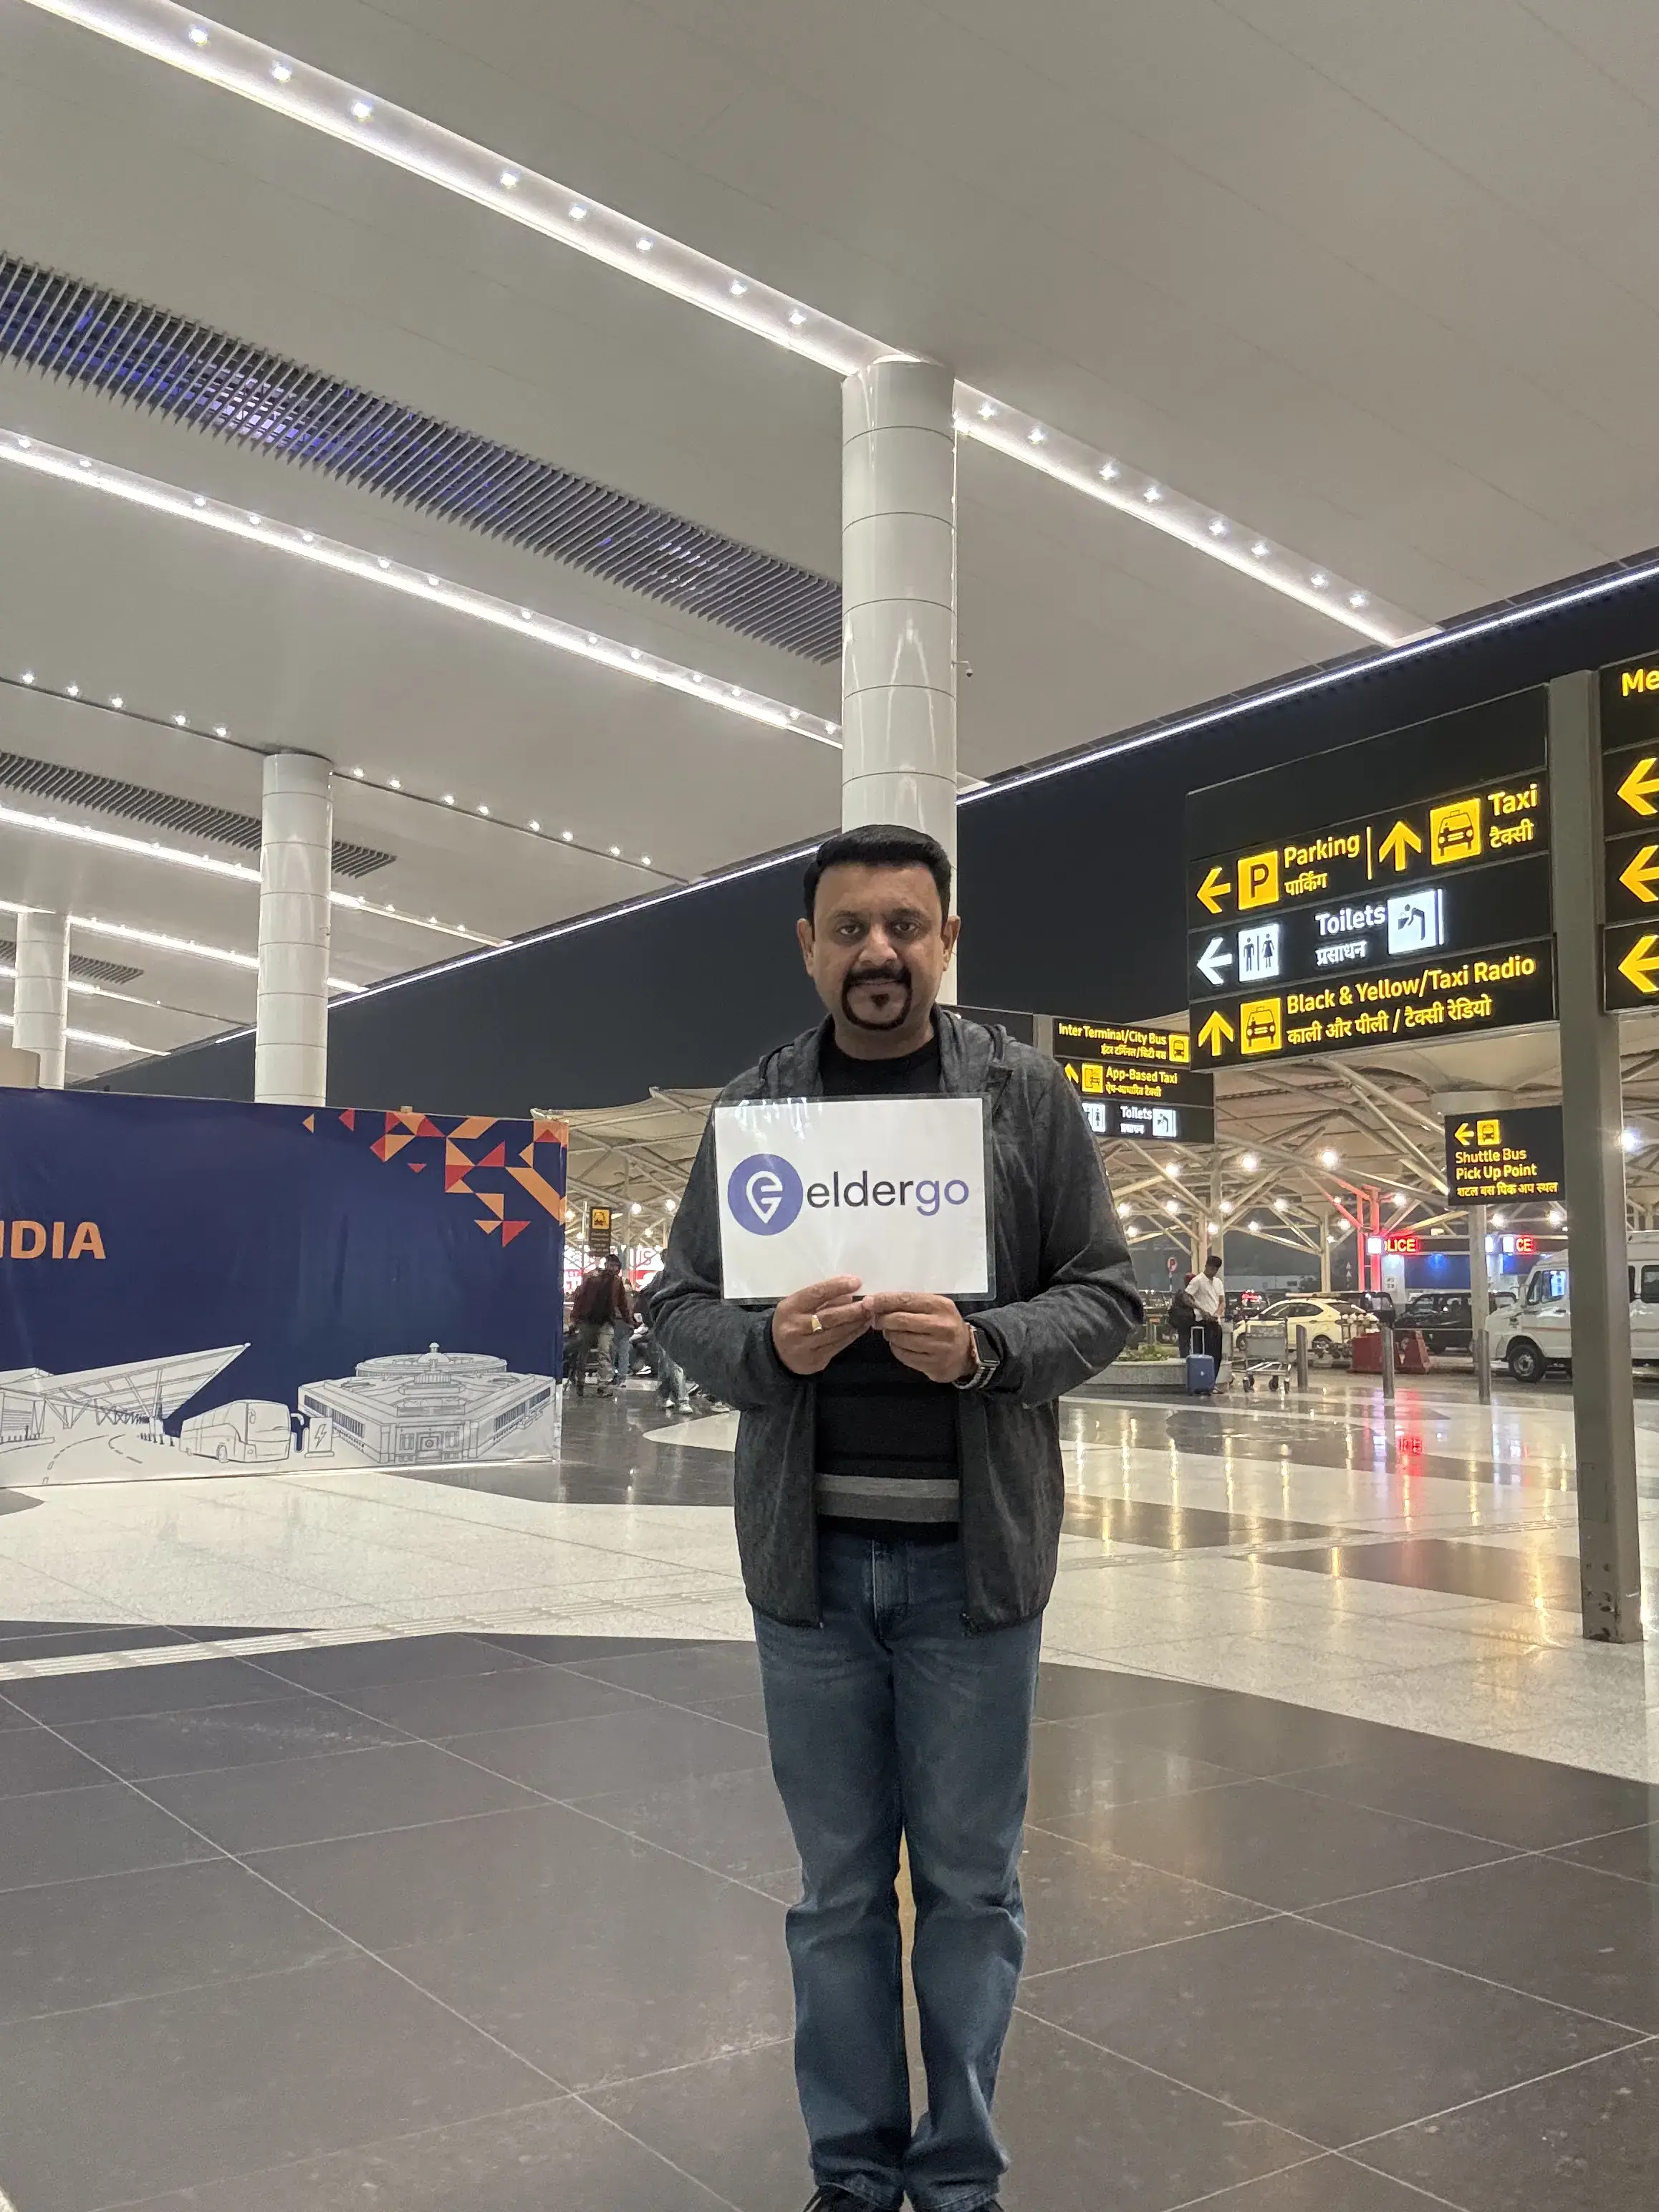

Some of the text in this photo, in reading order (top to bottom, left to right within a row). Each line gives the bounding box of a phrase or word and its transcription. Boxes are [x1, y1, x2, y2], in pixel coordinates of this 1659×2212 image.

[1487, 783, 1538, 816] Taxi
[1489, 818, 1534, 848] टैक्सी
[1250, 835, 1360, 898] P Parking
[1284, 870, 1327, 895] पार्किंग
[1315, 905, 1386, 936] Toilets
[1315, 941, 1367, 966] प्रसाधन
[1287, 955, 1535, 1014] Black & Yellow/Taxi Radio
[1286, 994, 1493, 1044] काली और पीली / टैक्सी रेडियो
[1059, 1023, 1167, 1045] Inter Terminal/City Bus
[1106, 1066, 1178, 1084] App-Based Taxi
[1120, 1105, 1152, 1120] Toilets
[1456, 1148, 1527, 1163] Shuttle Bus
[1456, 1163, 1537, 1180] Pick Up Point
[807, 1170, 968, 1216] eldergo
[1383, 1238, 1416, 1252] LICE
